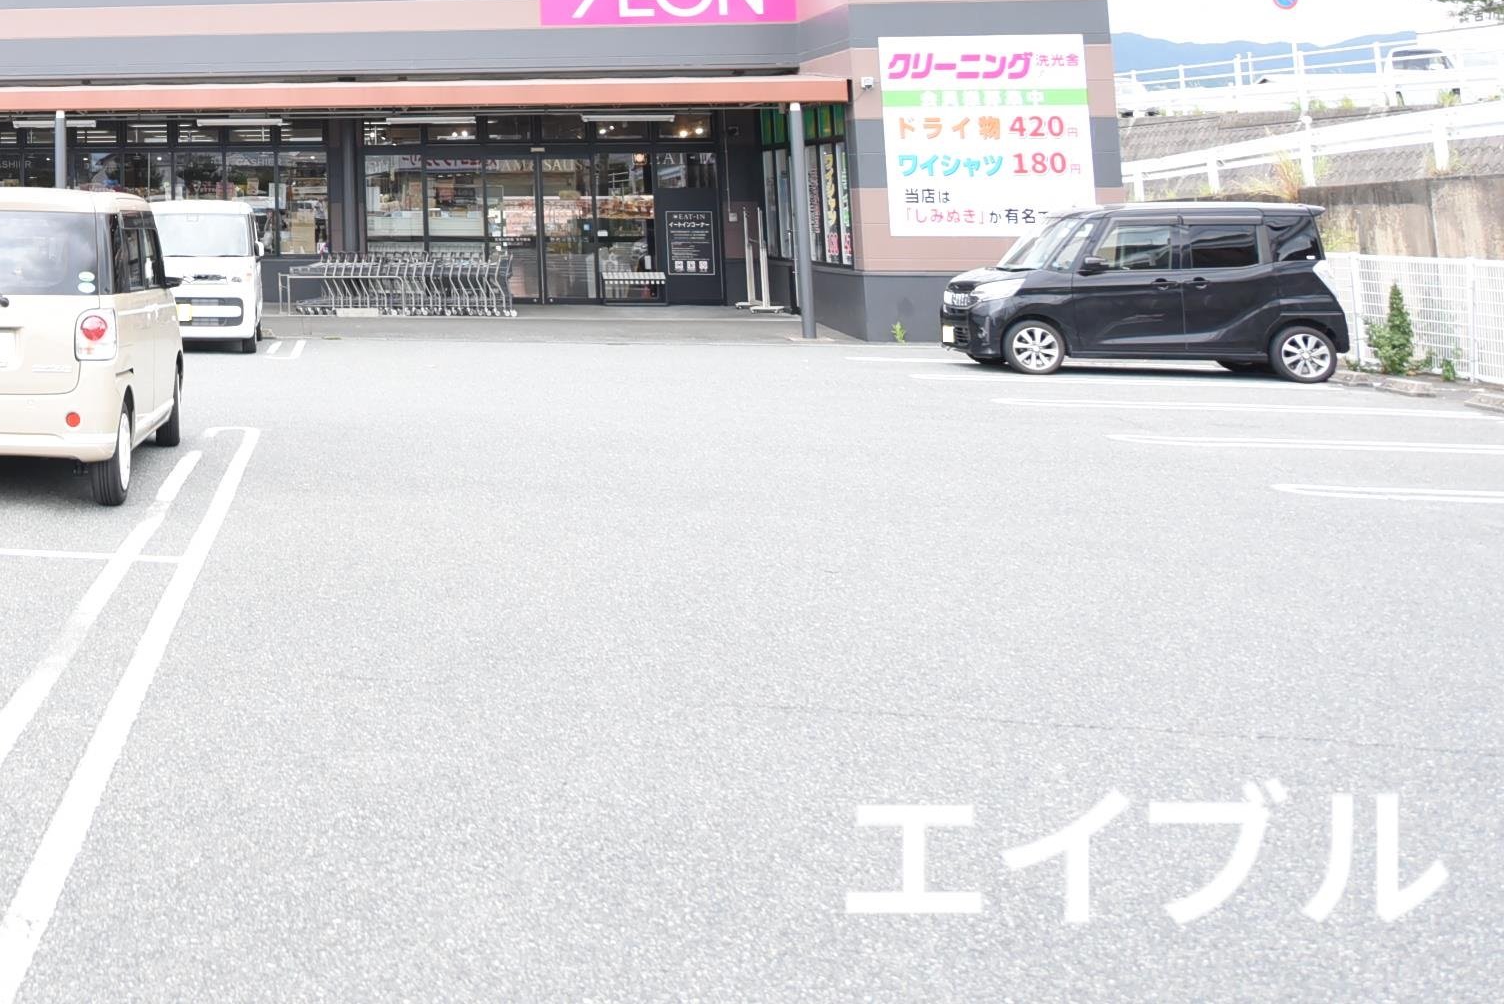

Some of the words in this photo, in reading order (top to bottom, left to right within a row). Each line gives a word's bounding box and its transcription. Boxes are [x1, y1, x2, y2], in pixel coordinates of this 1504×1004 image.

[888, 52, 1033, 79] クリーニング
[898, 116, 1001, 140] ドライ物
[898, 153, 1003, 177] ワイシャツ
[904, 188, 950, 204] 当店は
